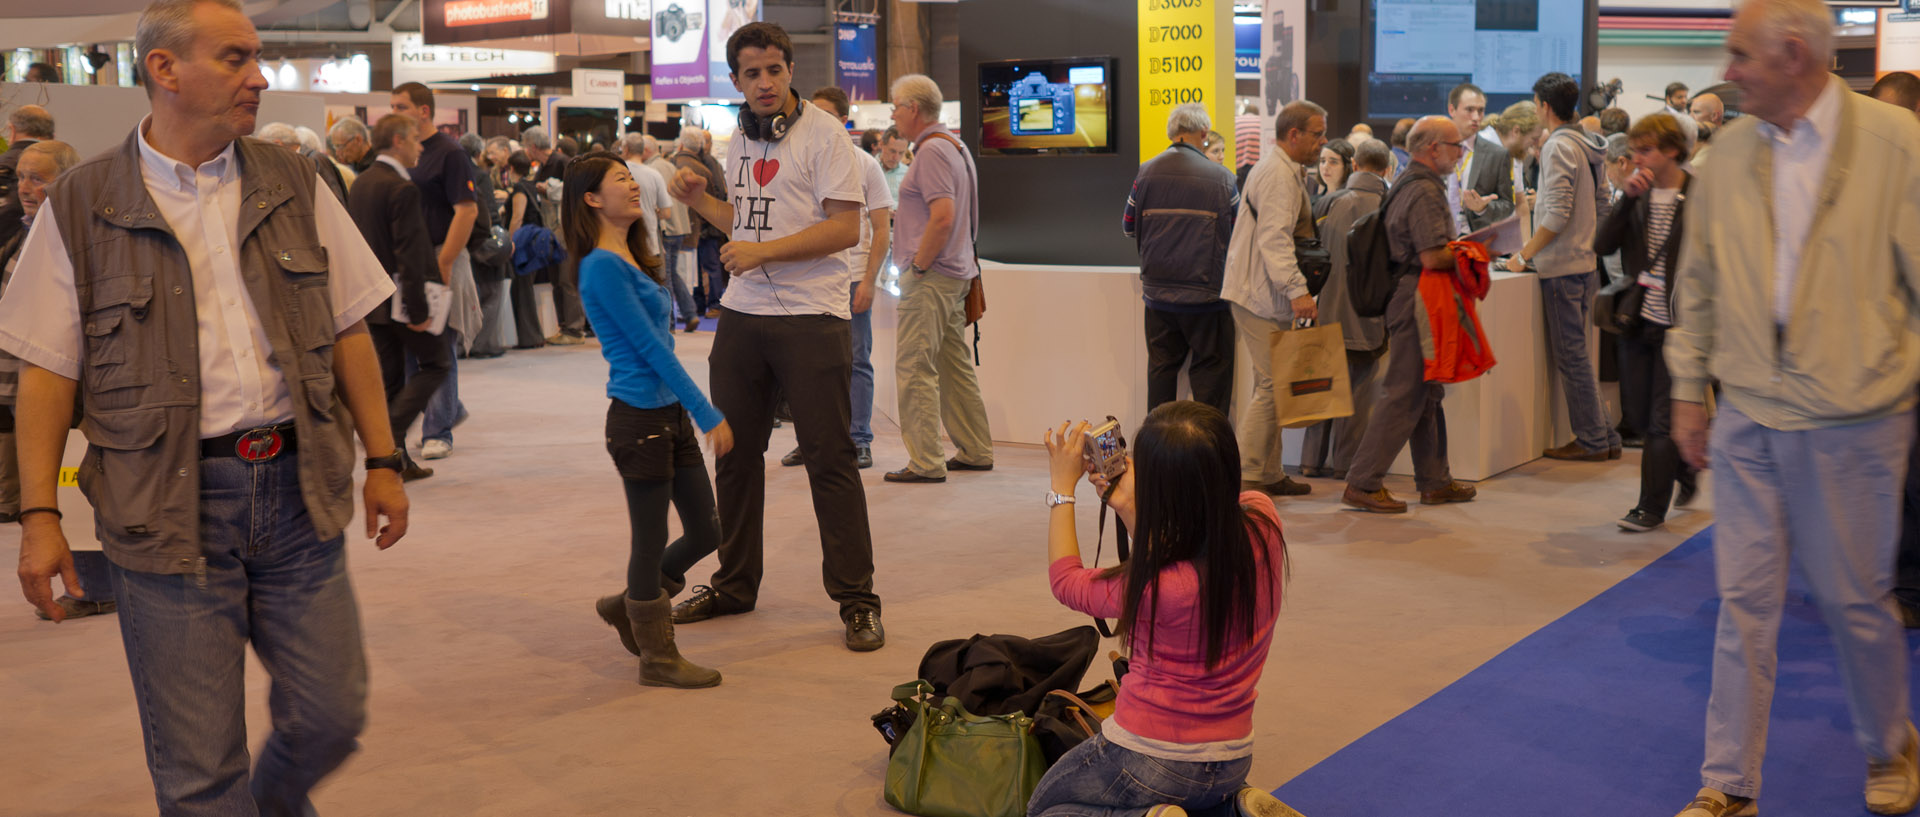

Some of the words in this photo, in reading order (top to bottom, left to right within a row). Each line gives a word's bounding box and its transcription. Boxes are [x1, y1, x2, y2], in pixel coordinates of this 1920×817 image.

[1149, 24, 1202, 42] D7000
[448, 52, 504, 61] TECH
[1150, 56, 1203, 74] D5100
[590, 78, 617, 88] Canon
[1150, 88, 1203, 105] D3100
[735, 156, 751, 188] I
